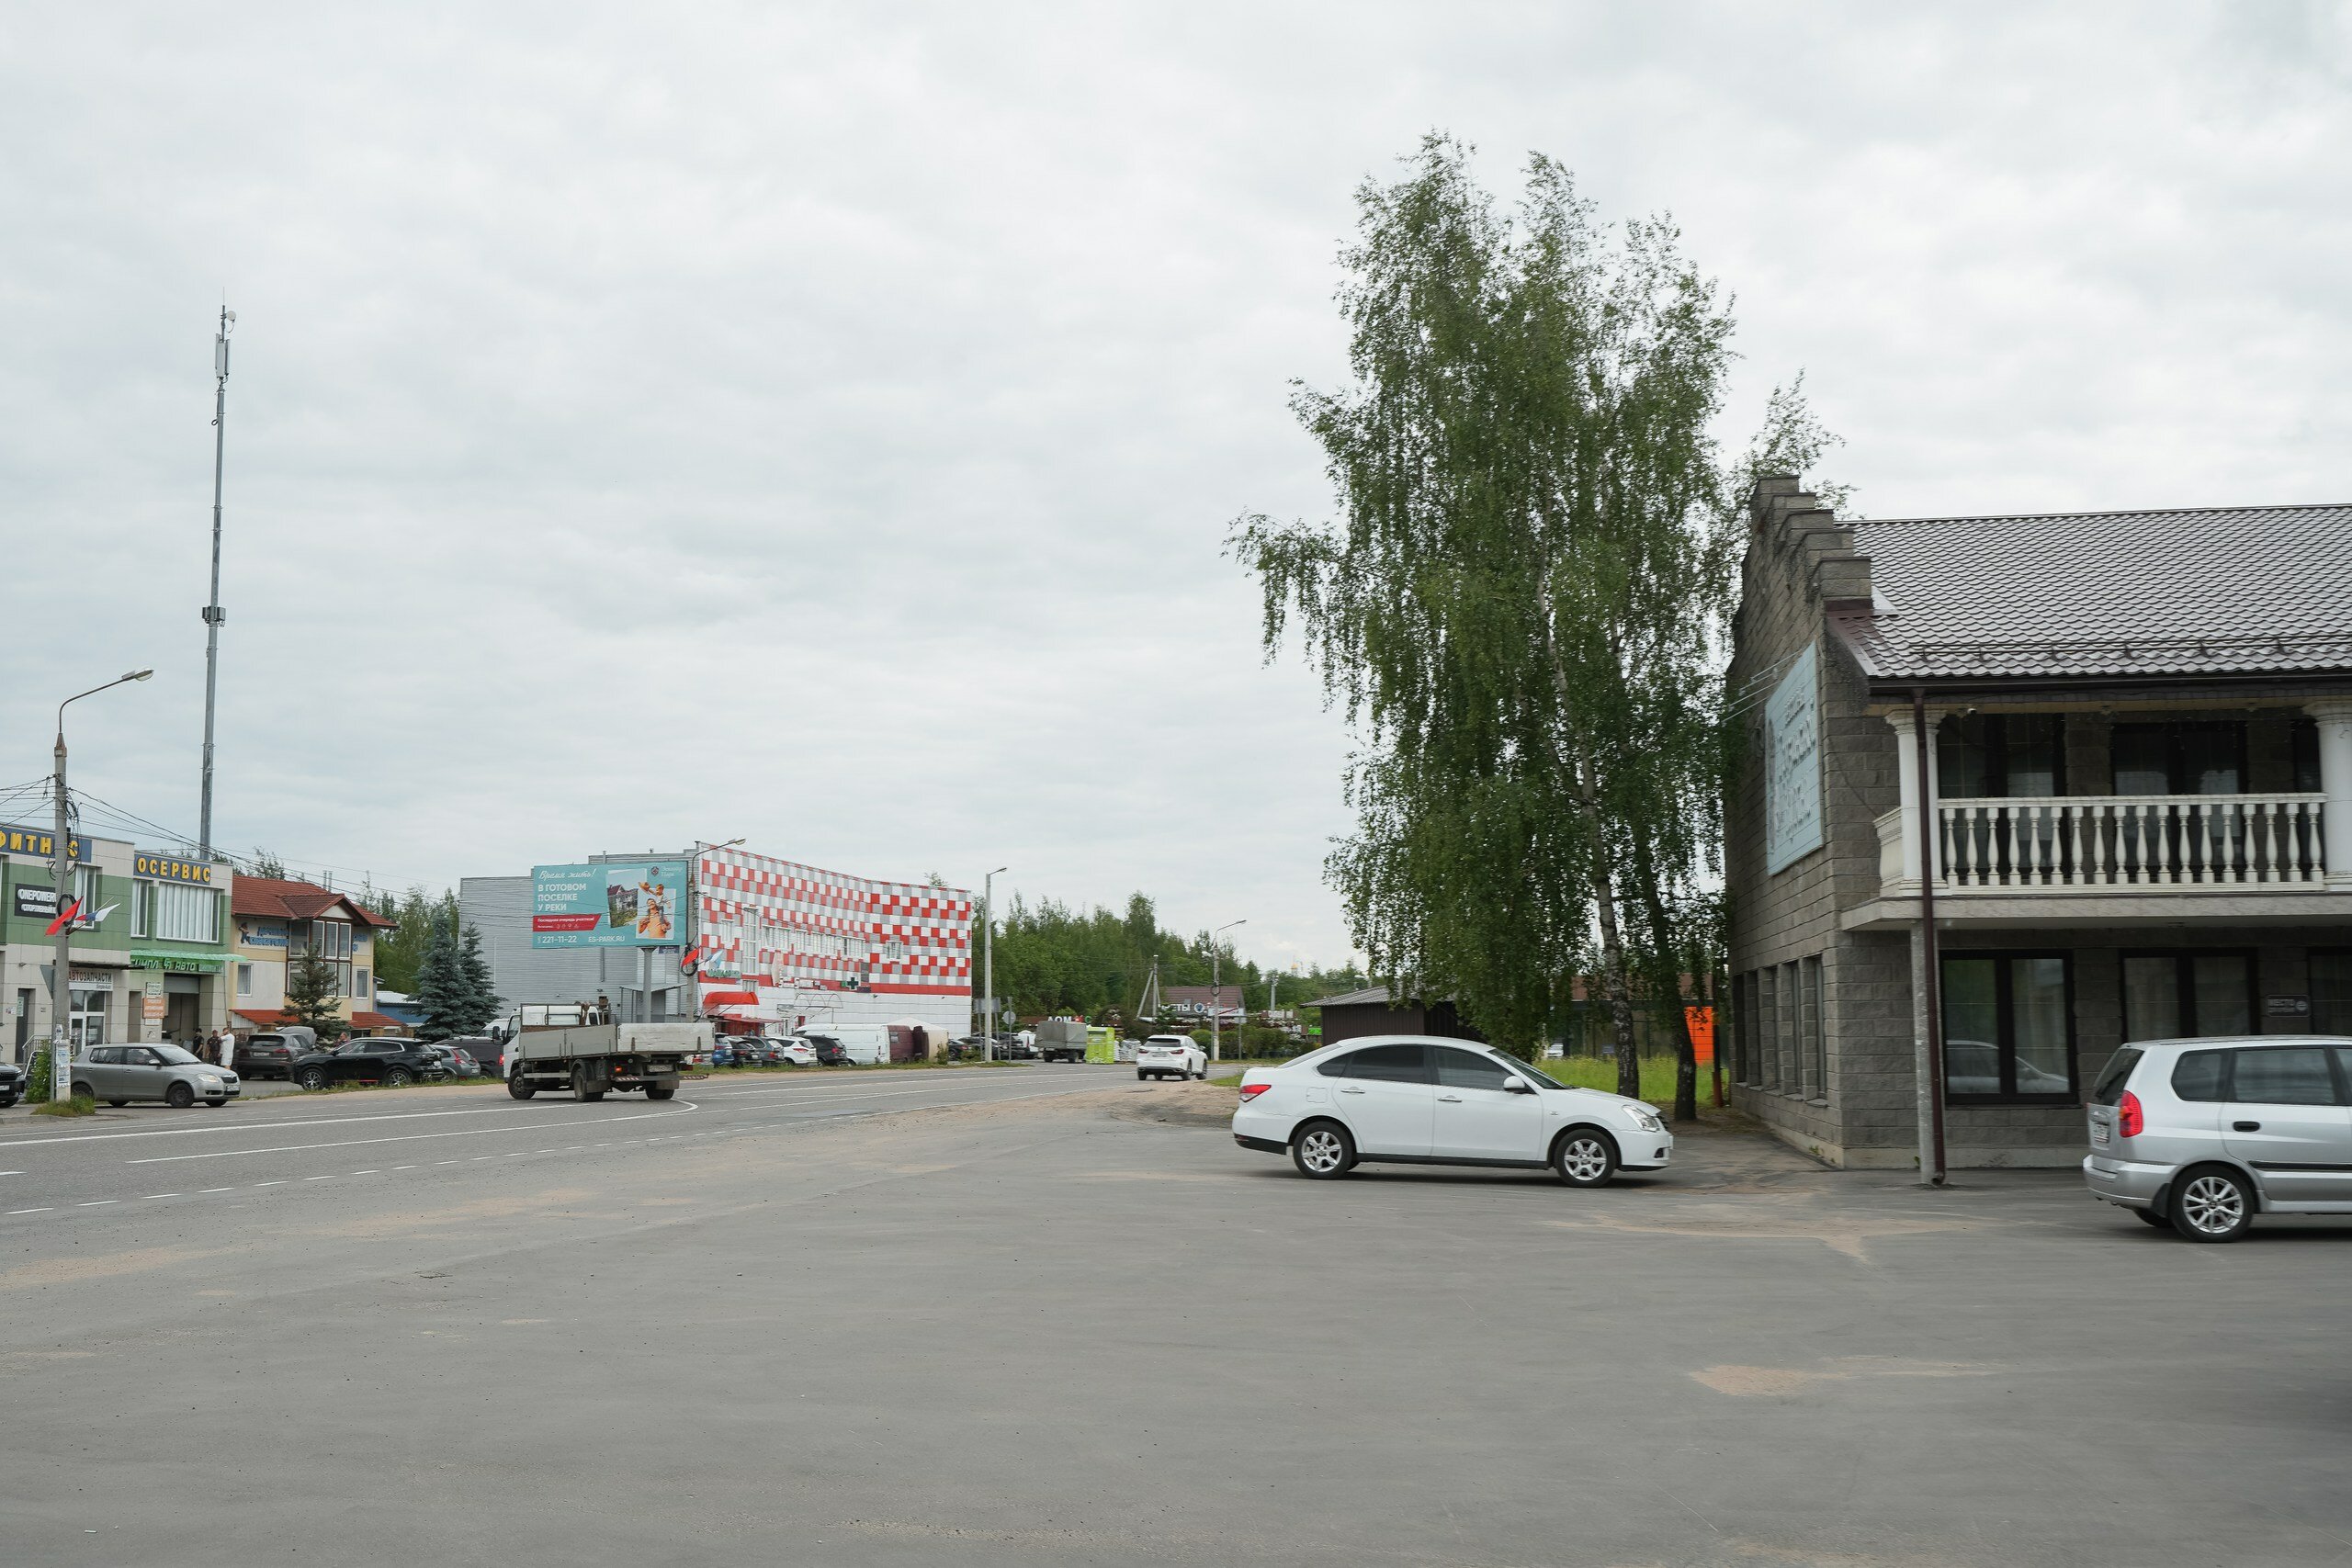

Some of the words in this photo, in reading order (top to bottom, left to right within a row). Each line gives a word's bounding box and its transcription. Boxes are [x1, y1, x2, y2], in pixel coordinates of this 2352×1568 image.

[138, 857, 210, 882] ОСЕРВИС
[538, 870, 565, 881] Время
[568, 868, 596, 879] жить!
[537, 884, 544, 892] В
[546, 883, 587, 892] ГОТОВОМ
[537, 893, 578, 902] ПОСЕЛКЕ
[537, 903, 544, 911] У
[546, 903, 567, 911] РЕКИ
[542, 935, 578, 943] 221-11-22
[588, 935, 625, 943] ES-PARK.RU
[175, 962, 196, 971] АВТО
